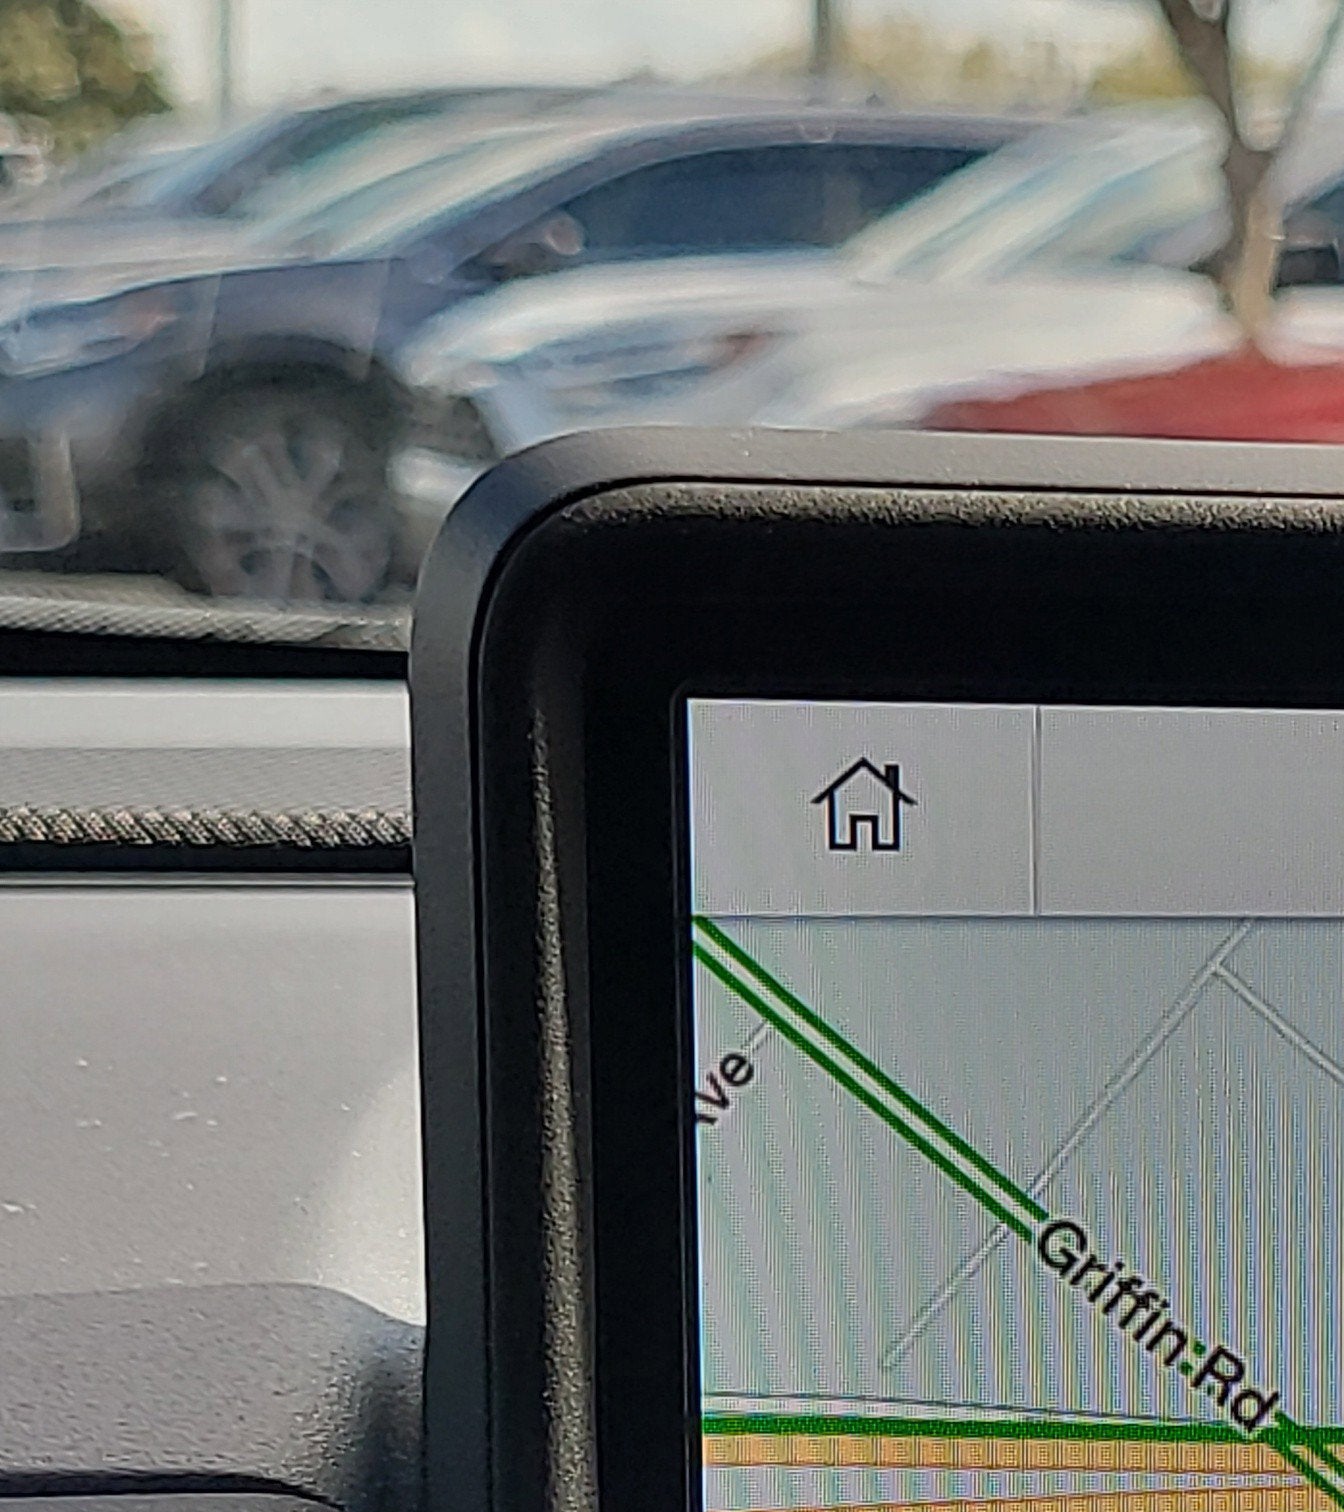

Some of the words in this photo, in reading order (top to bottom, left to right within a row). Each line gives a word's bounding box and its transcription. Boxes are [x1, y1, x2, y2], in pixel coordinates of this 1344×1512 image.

[694, 1052, 754, 1125] ve
[1037, 1220, 1189, 1367] Griffin
[1191, 1345, 1280, 1433] Rd
